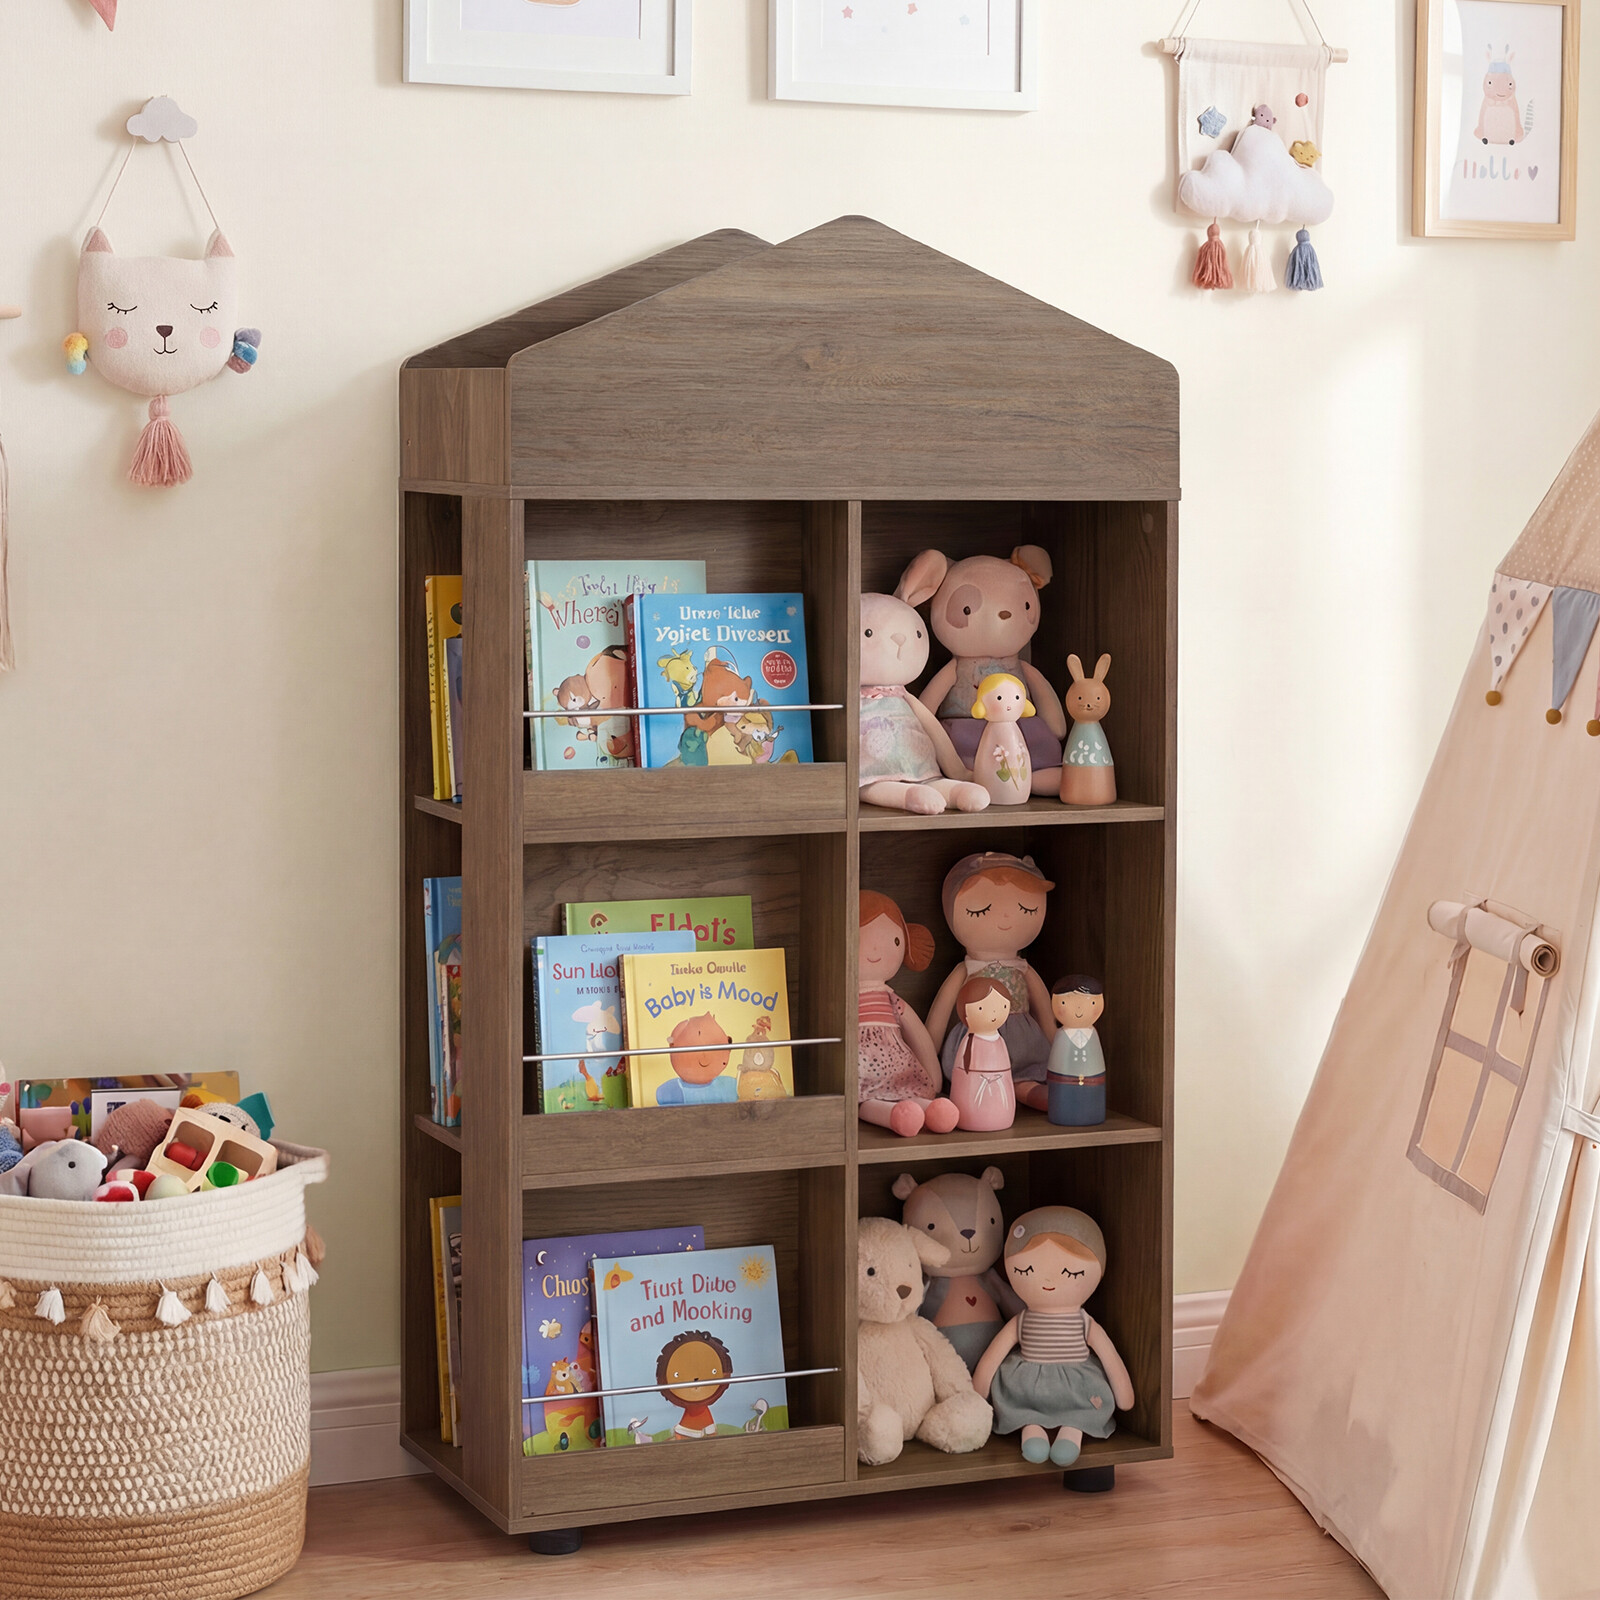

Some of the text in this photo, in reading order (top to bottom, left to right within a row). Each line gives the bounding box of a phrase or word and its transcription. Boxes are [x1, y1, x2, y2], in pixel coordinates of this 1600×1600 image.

[552, 963, 586, 980] Sun
[644, 980, 779, 1019] Baby is Mood
[630, 1298, 752, 1332] and Mooking
